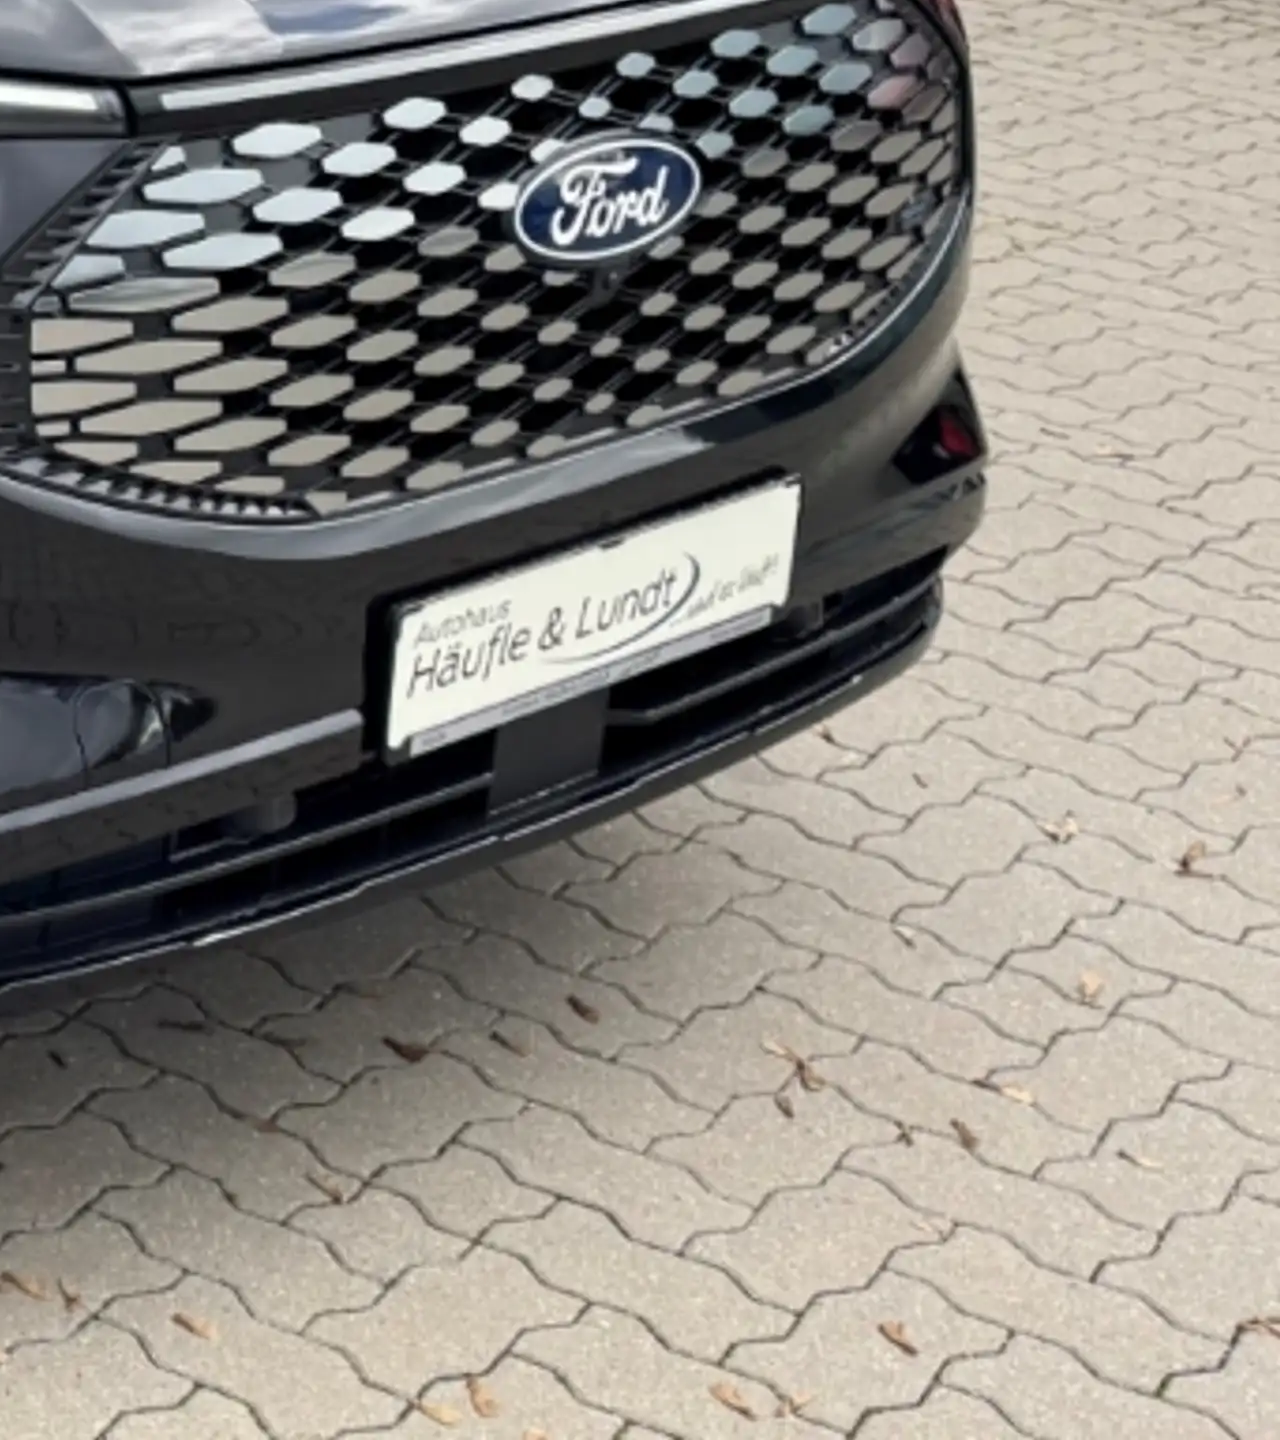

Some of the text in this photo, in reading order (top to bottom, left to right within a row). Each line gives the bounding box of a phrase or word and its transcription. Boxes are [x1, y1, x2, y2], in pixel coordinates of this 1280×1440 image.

[550, 156, 670, 246] Ford
[406, 620, 533, 700] Häufle
[538, 606, 567, 652] &
[574, 567, 678, 640] Lundt
